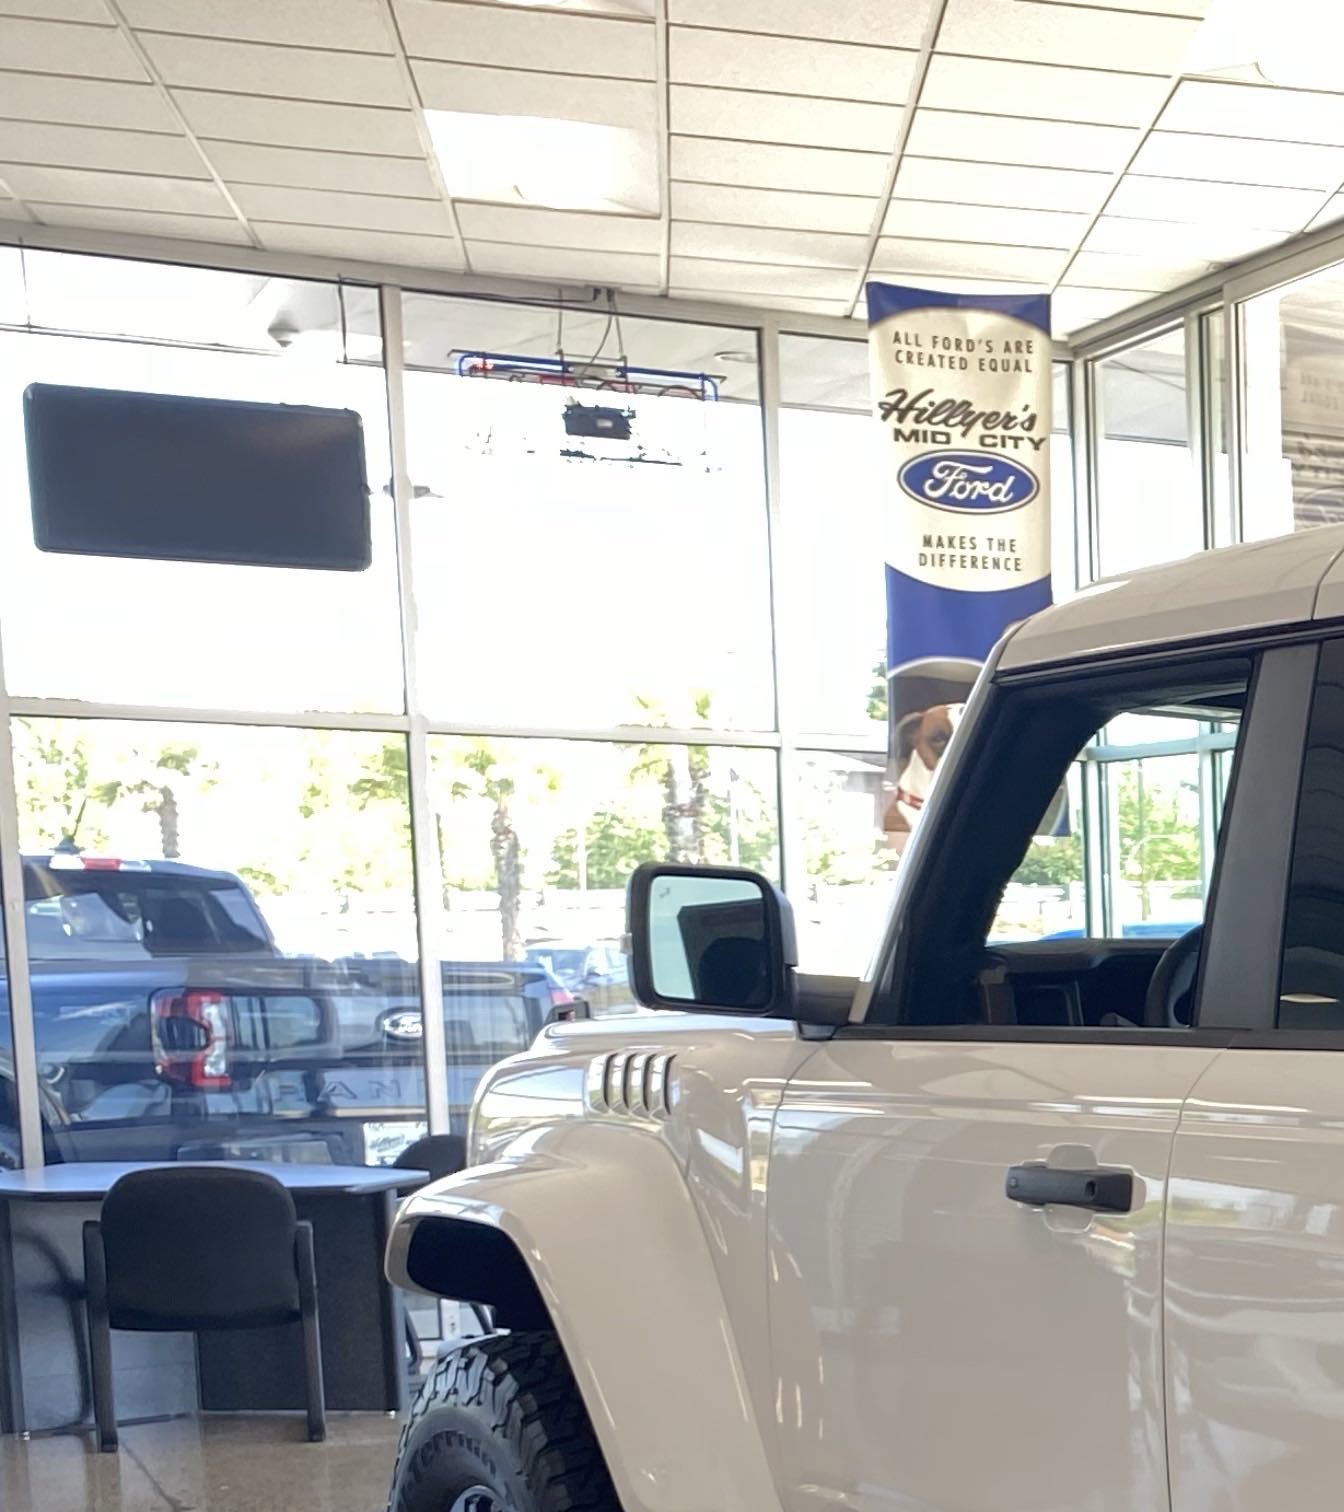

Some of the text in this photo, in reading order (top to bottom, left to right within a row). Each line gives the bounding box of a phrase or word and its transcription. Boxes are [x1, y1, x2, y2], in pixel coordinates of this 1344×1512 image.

[892, 331, 1034, 355] ALL FORD'S ARE
[895, 350, 1033, 373] CREATED EQUAL
[877, 388, 1038, 438] Hillyer's
[893, 428, 1046, 451] MID CITY
[923, 460, 1016, 503] Ford
[922, 534, 1017, 553] MAKES THE
[918, 553, 1023, 572] DIFFERENCE
